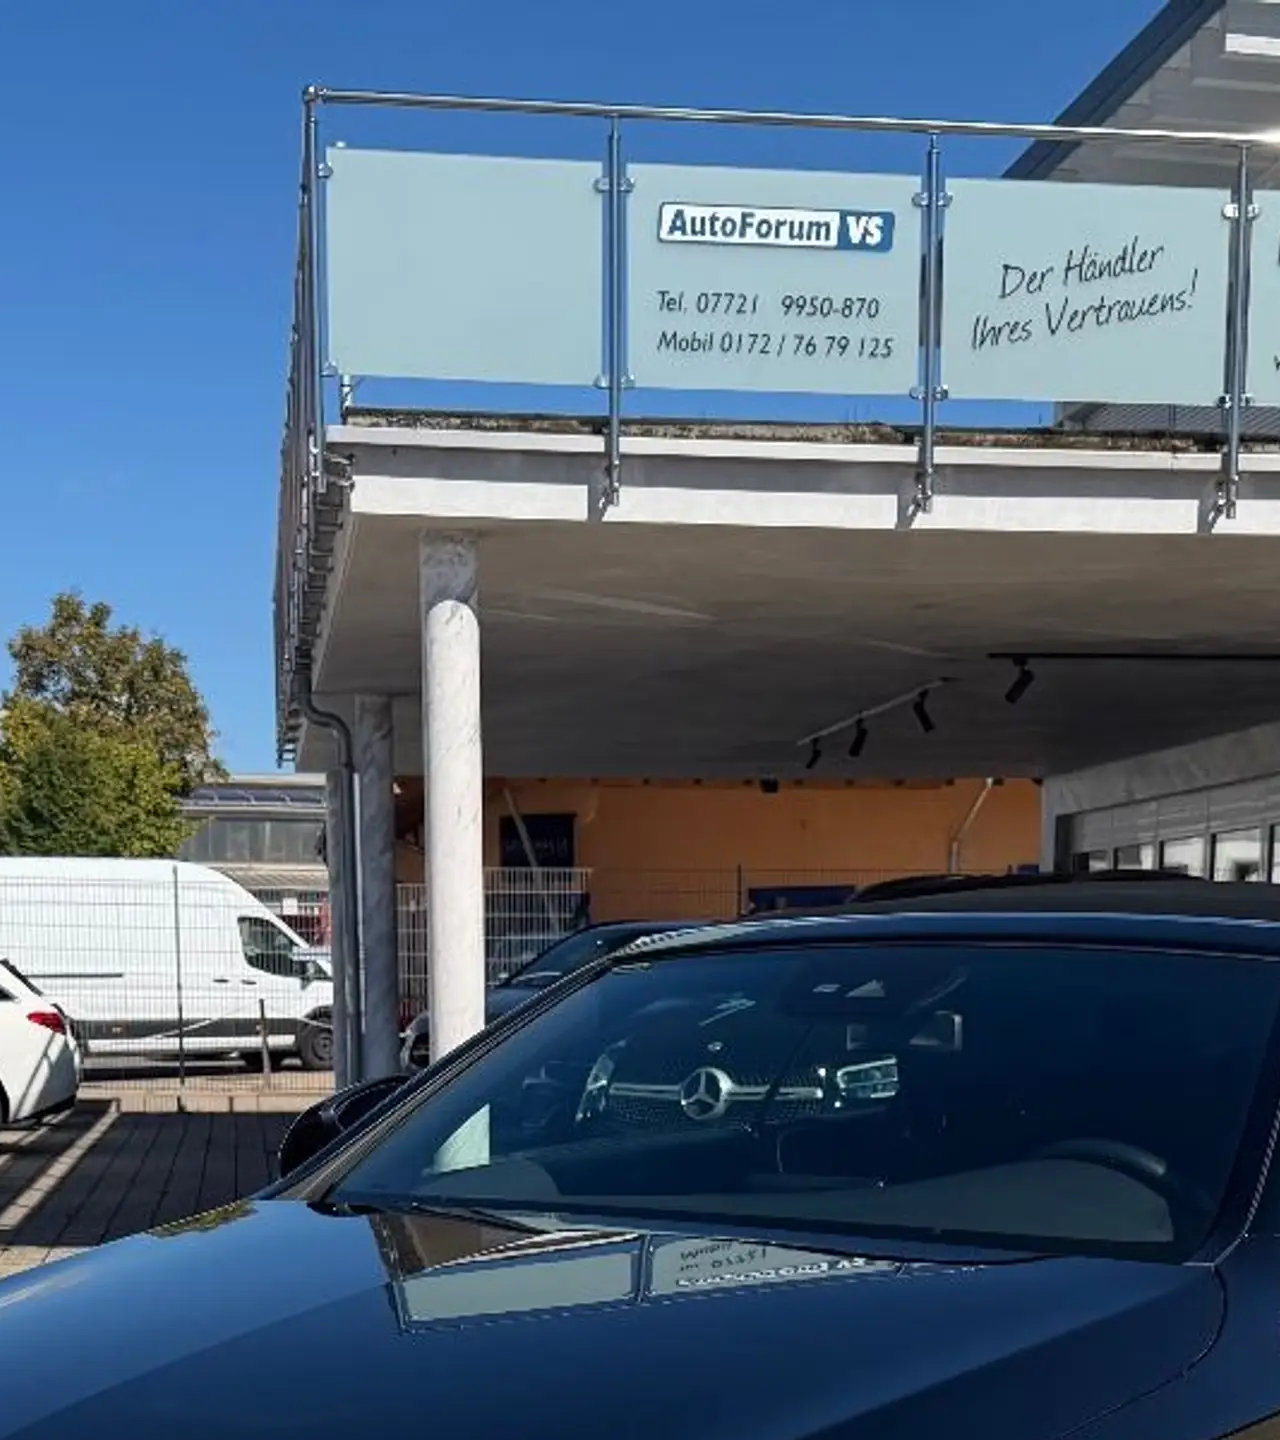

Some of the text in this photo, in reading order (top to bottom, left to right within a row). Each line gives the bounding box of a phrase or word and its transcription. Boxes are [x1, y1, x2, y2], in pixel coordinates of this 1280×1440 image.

[667, 207, 884, 245] AutoForum VS
[998, 235, 1165, 300] Der Händler
[656, 290, 881, 319] Tel. 07721 9950-870
[971, 267, 1200, 351] Ihres Vertrauens!
[656, 331, 715, 353] Mobil
[719, 334, 772, 355] 0172
[792, 335, 818, 357] 76
[824, 336, 851, 357] 79
[856, 337, 894, 359] 125
